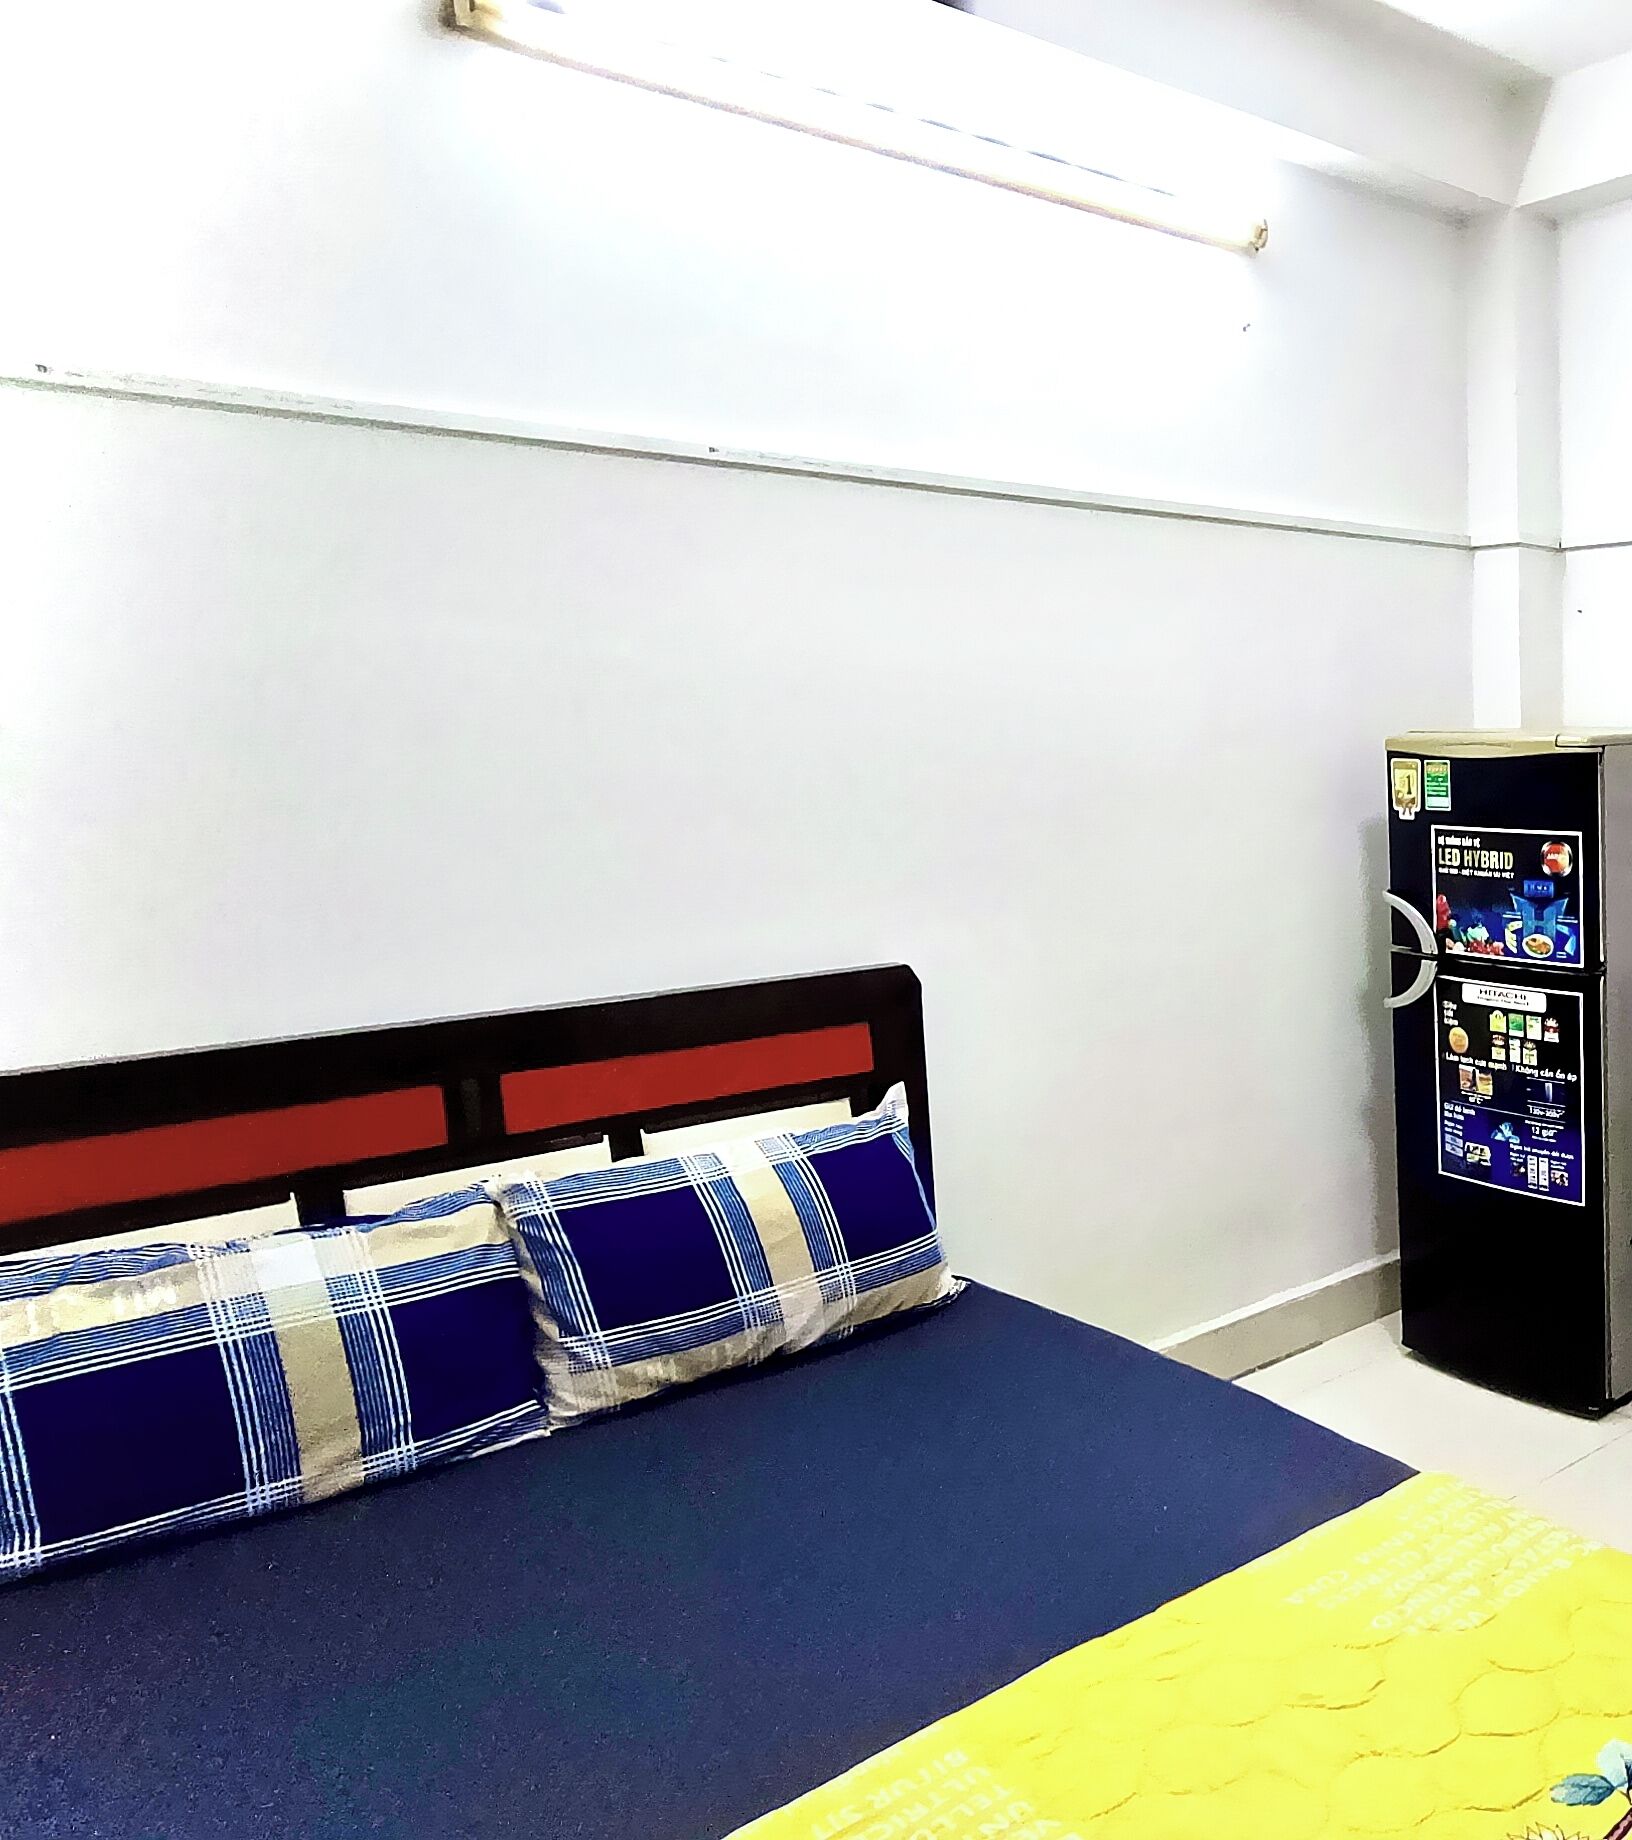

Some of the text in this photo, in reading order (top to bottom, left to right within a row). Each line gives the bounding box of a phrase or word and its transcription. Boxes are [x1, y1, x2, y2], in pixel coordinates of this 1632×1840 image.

[1438, 847, 1514, 870] LED HYBRID
[1479, 989, 1527, 1000] HITACHI
